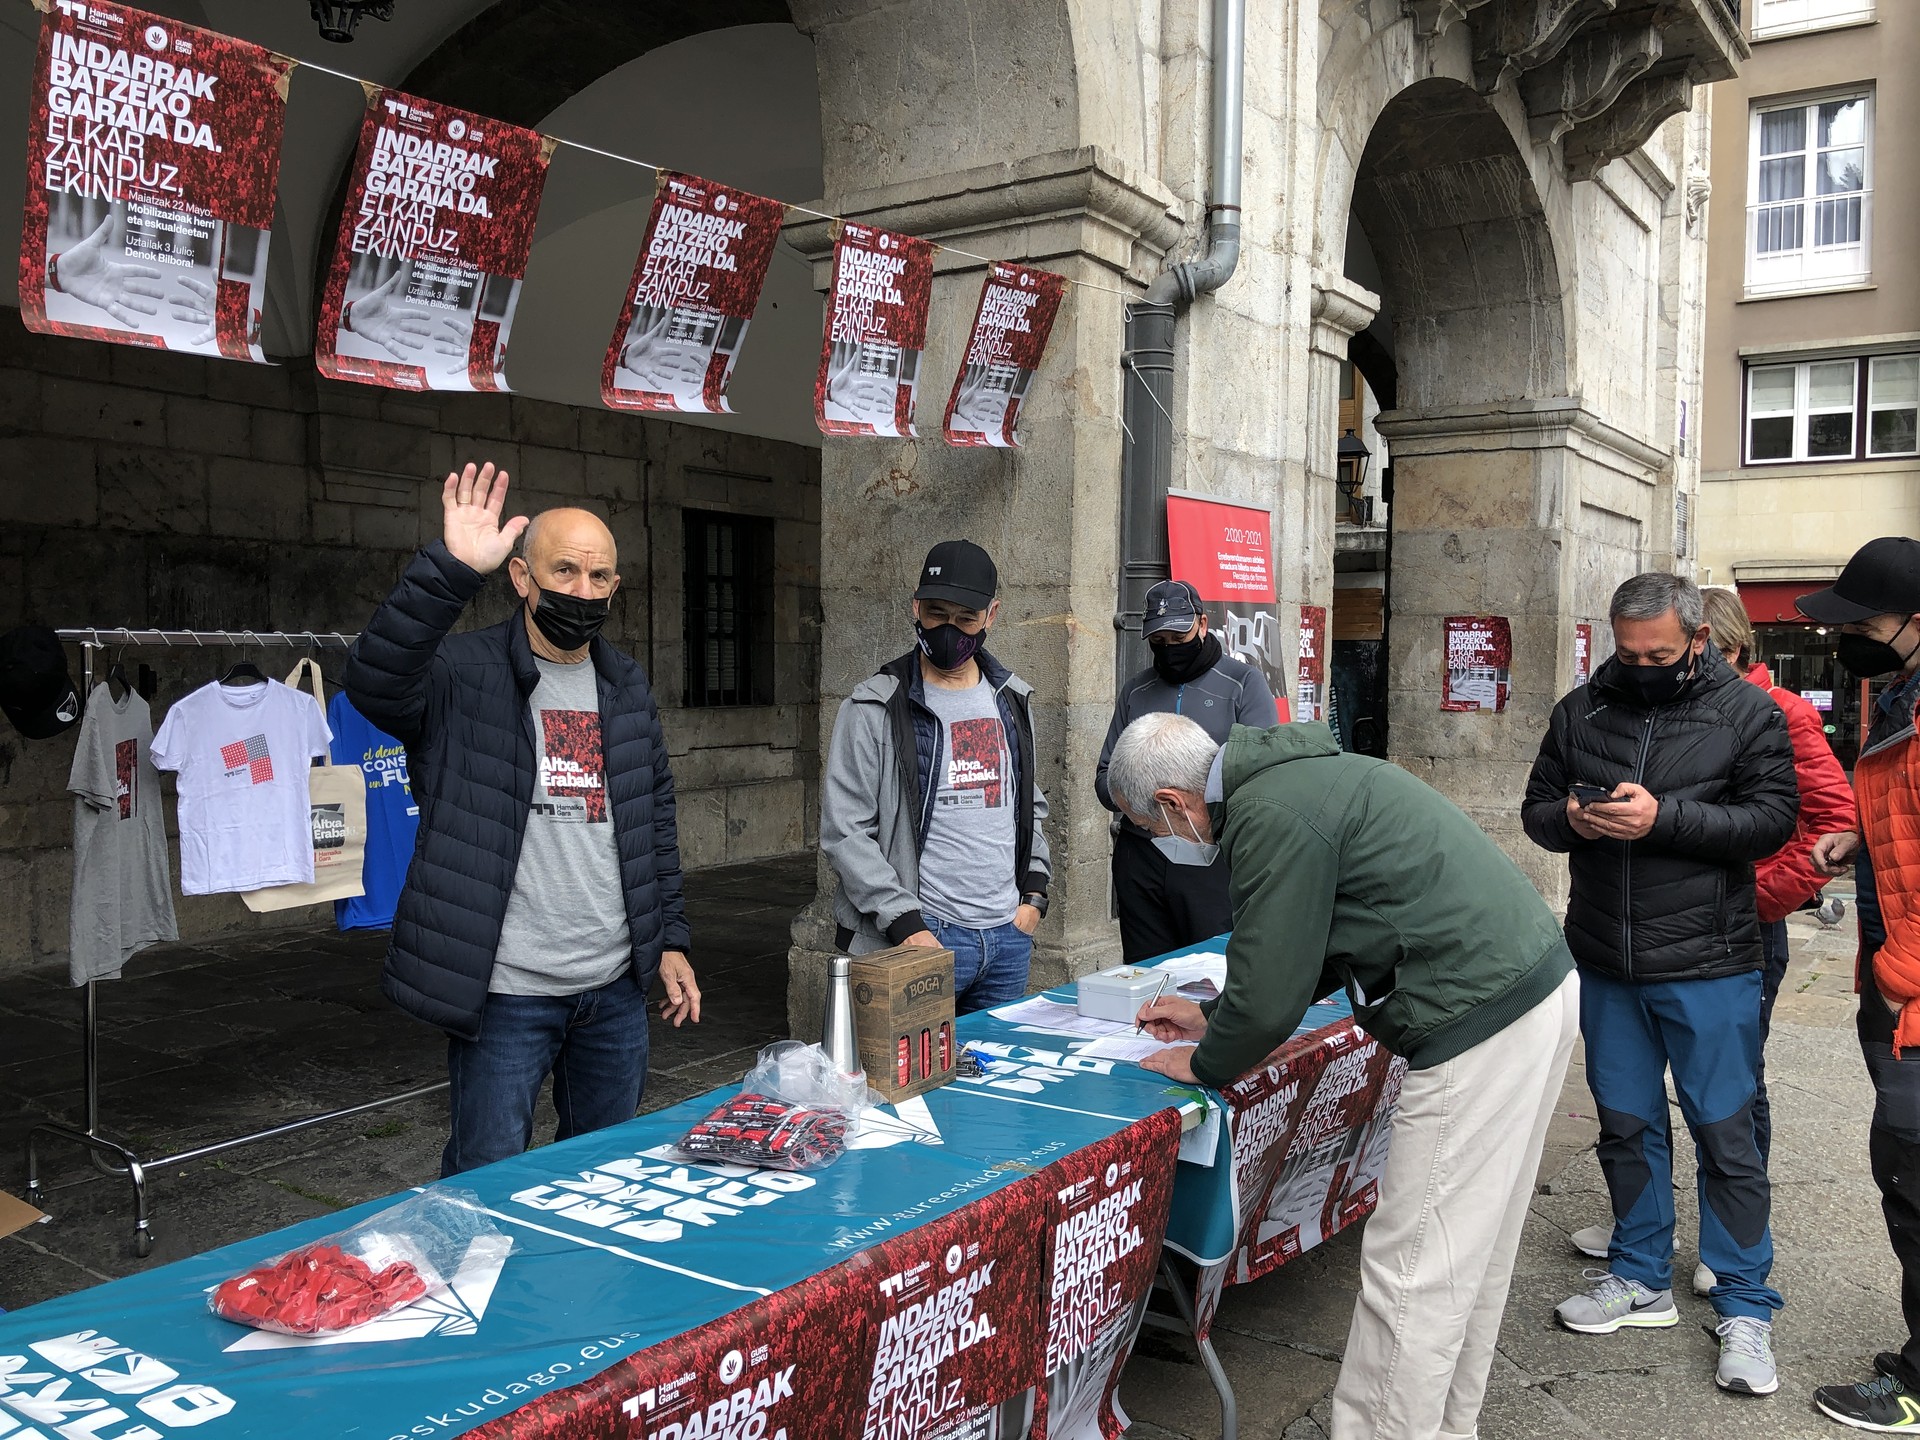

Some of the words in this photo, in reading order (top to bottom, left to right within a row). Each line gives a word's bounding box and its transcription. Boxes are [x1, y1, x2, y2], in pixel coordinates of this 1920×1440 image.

[89, 15, 108, 27] Gara
[90, 7, 124, 24] Hamaika
[175, 39, 193, 50] GURE
[175, 45, 192, 55] ESKU
[51, 31, 219, 102] INDARRAK
[50, 58, 191, 118] BATZEKO
[48, 86, 168, 140] GARAIA
[173, 120, 222, 153] DA.
[408, 113, 422, 122] Gara
[409, 106, 435, 119] Hamaika
[48, 112, 145, 159] ELKAR
[376, 126, 499, 178] INDARRAK
[45, 137, 184, 197] ZAINDUZ,
[371, 148, 475, 192] BATZEKO
[45, 166, 122, 205] EKIN!
[366, 170, 454, 210] GARAIA
[458, 194, 493, 219] DA.
[127, 202, 193, 227] Mobilizazioak
[193, 216, 215, 229] herri
[128, 190, 171, 209] Maiatzak
[172, 198, 184, 210] 22
[185, 201, 213, 218] Mayo:
[361, 190, 436, 225] ELKAR
[127, 216, 145, 228] eta
[145, 219, 209, 240] eskualdeetan
[355, 211, 460, 255] ZAINDUZ,
[659, 203, 747, 240] INDARRAK
[125, 236, 163, 252] Uztailak
[165, 242, 171, 252] 3
[172, 243, 195, 257] Julio:
[351, 232, 413, 263] EKIN!
[653, 221, 728, 253] BATZEKO
[125, 247, 155, 262] Denok
[157, 253, 195, 268] Bilbora!
[417, 252, 448, 267] Maiatzak
[449, 258, 458, 267] 22
[459, 259, 479, 271] Mayo:
[643, 254, 697, 281] ELKAR
[649, 239, 711, 269] GARAIA
[714, 252, 738, 273] DA.
[840, 245, 907, 275] INDARRAK
[412, 271, 424, 280] eta
[424, 272, 473, 288] eskualdeetan
[414, 261, 461, 279] Mobilizazioak
[462, 269, 479, 280] herri
[838, 262, 893, 288] BATZEKO
[407, 286, 435, 299] Uztailak
[442, 291, 460, 303] Julio:
[637, 271, 710, 303] ZAINDUZ,
[836, 278, 883, 302] GARAIA
[885, 287, 905, 306] DA.
[986, 283, 1040, 308] INDARRAK
[405, 296, 429, 308] Denok
[430, 299, 458, 312] Bilbora!
[633, 288, 676, 311] EKIN!
[834, 294, 874, 315] ELKAR
[982, 299, 1026, 319] BATZEKO
[832, 309, 888, 336] ZAINDUZ,
[974, 324, 1005, 342] ELKAR
[978, 312, 1014, 330] GARAIA
[1016, 319, 1031, 333] DA.
[830, 325, 863, 346] EKIN!
[966, 351, 992, 367] EKIN!
[970, 337, 1012, 359] ZAINDUZ,
[1224, 527, 1262, 545] 2020-2021
[1449, 630, 1493, 638] INDARRAK
[1449, 637, 1486, 645] BATZEKO
[1448, 643, 1480, 651] GARAIA
[1482, 643, 1496, 651] DA.
[1448, 656, 1486, 664] ZAINDUZ,
[1448, 662, 1470, 670] EKIN!
[539, 756, 583, 772] Altxa.
[948, 767, 999, 785] Erabaki.
[949, 759, 984, 773] Altxa.
[540, 772, 601, 788] Erabaki.
[313, 818, 345, 830] Altxa.
[556, 809, 572, 817] Gara
[314, 826, 359, 840] Erabaki.
[909, 976, 940, 998] BOGA
[1322, 1041, 1379, 1078] INDARRAK
[1314, 1061, 1367, 1095] BATZEKO
[1306, 1083, 1350, 1110] GARAIA
[1351, 1073, 1370, 1096] DA.
[1238, 1079, 1300, 1133] INDARRAK
[1299, 1099, 1340, 1126] ELKAR
[1234, 1105, 1288, 1154] BATZEKO
[1292, 1109, 1347, 1144] ZAINDUZ,
[1284, 1133, 1321, 1161] EKIN!
[1055, 1177, 1144, 1248] INDARRAK
[966, 1241, 979, 1253] GURE
[966, 1248, 979, 1259] ESKU
[1053, 1211, 1128, 1277] BATZEKO
[904, 1261, 931, 1280] Hamaika
[1051, 1247, 1116, 1299] GARAIA
[1118, 1225, 1145, 1260] DA.
[904, 1275, 920, 1288] Gara
[877, 1259, 996, 1350] INDARRAK
[1050, 1271, 1104, 1324] ELKAR
[1047, 1282, 1122, 1351] ZAINDUZ,
[872, 1297, 973, 1380] BATZEKO
[750, 1344, 769, 1359] GURE
[750, 1353, 769, 1367] ESKU
[868, 1332, 954, 1405] GARAIA
[958, 1312, 997, 1351] DA.
[1045, 1327, 1092, 1378] EKIN!
[658, 1371, 696, 1395] Hamaika
[658, 1391, 680, 1405] Gara
[863, 1367, 938, 1437] ELKAR
[955, 1411, 966, 1424] 22
[967, 1400, 990, 1419] Mayo:
[973, 1410, 991, 1427] herri
